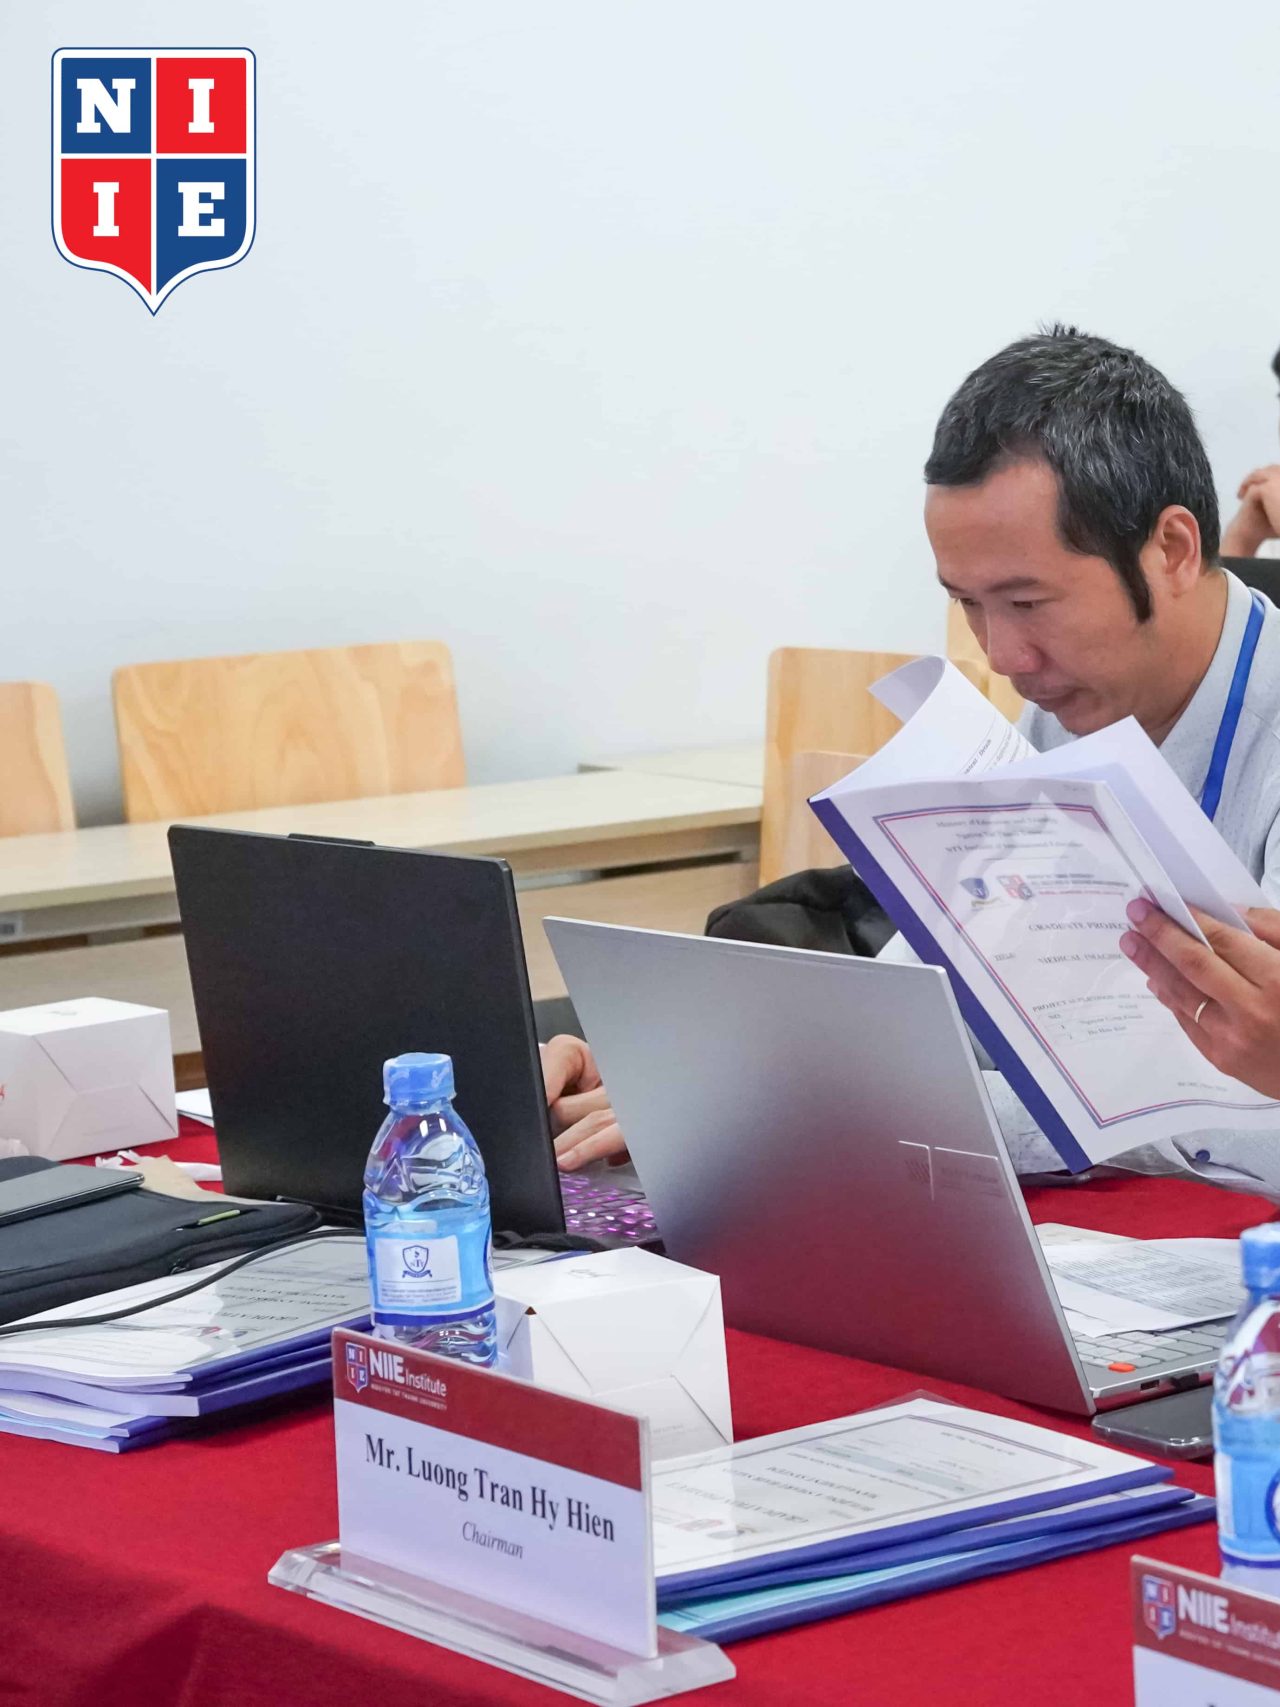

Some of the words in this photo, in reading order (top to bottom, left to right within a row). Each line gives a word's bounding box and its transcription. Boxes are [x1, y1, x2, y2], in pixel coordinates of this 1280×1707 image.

[369, 1348, 405, 1384] NIIE
[405, 1368, 447, 1397] Institute
[365, 1434, 401, 1472] Mr.
[407, 1447, 468, 1501] Luong
[474, 1468, 524, 1511] Tran
[531, 1486, 560, 1531] Hy
[567, 1497, 615, 1542] Hien
[462, 1521, 524, 1560] Chairman
[1177, 1584, 1231, 1634] NIIE
